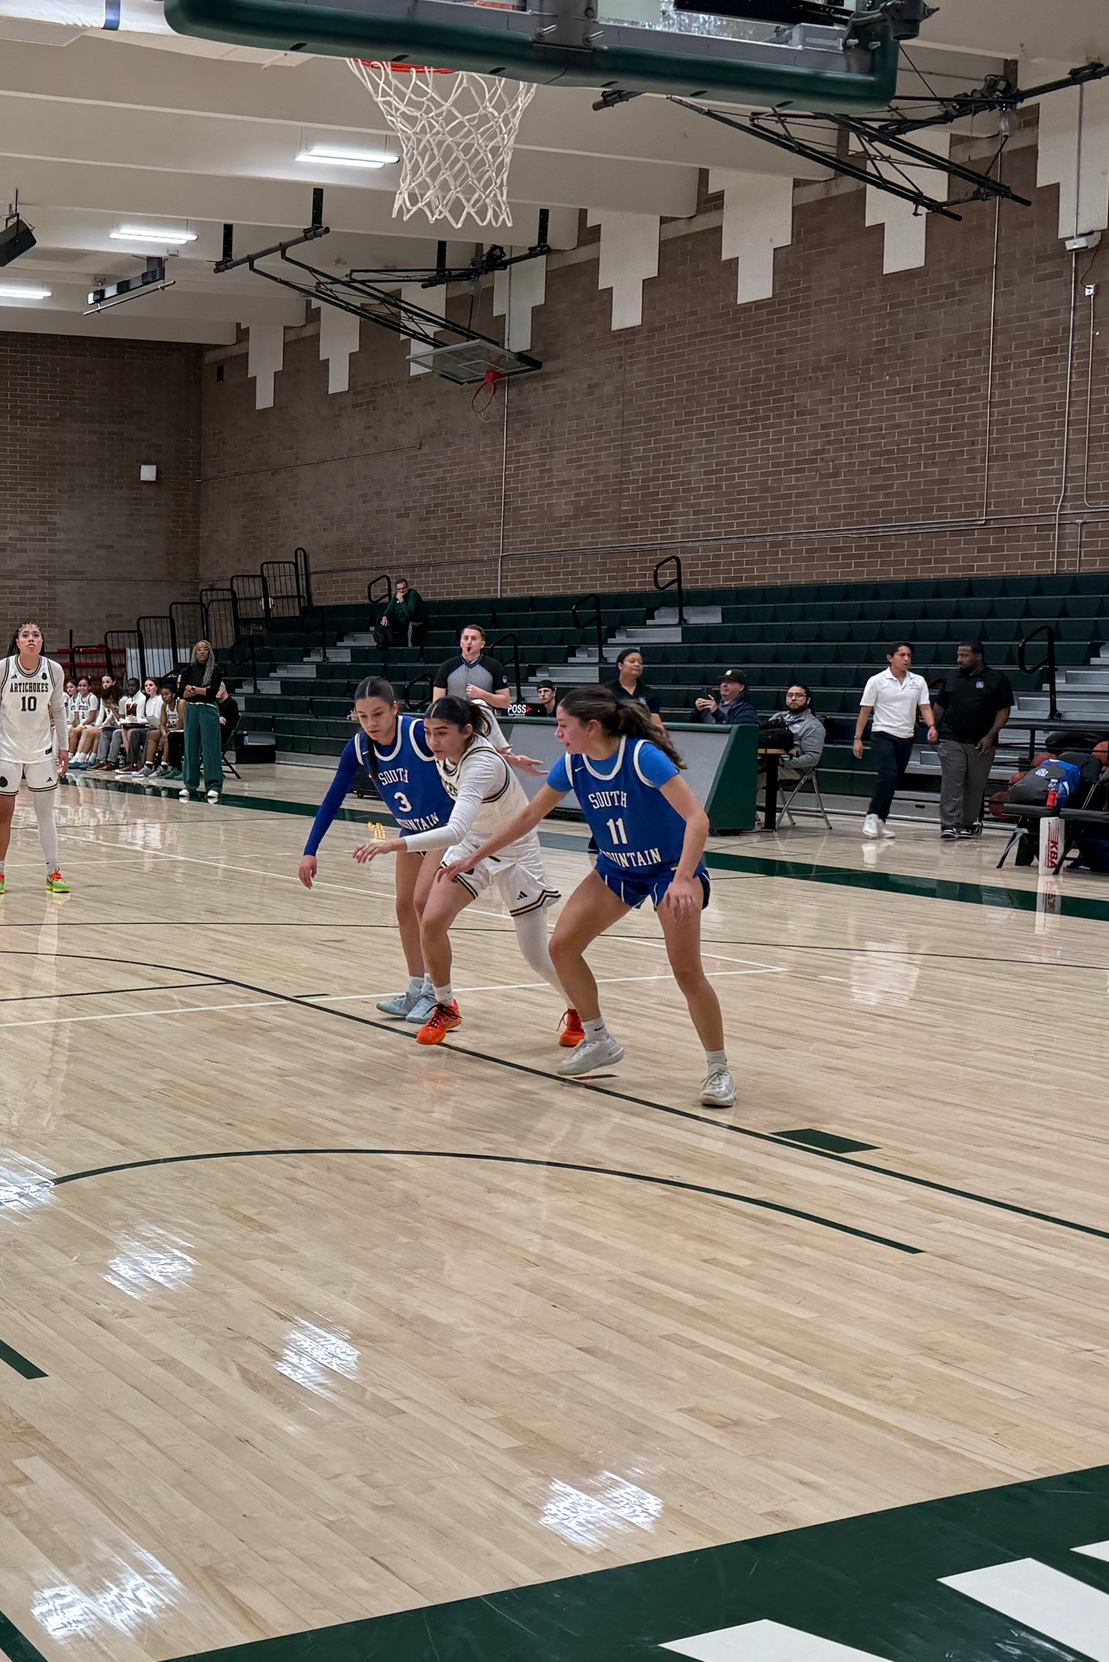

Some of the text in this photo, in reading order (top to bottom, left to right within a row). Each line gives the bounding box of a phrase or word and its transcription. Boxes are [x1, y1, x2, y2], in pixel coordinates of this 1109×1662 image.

[10, 682, 49, 693] ARTICHOKES
[21, 696, 37, 712] 10
[377, 767, 409, 785] SOUTH
[394, 792, 412, 812] 3
[588, 790, 628, 809] SOUTH
[606, 818, 628, 844] 11
[1050, 840, 1059, 868] KBA
